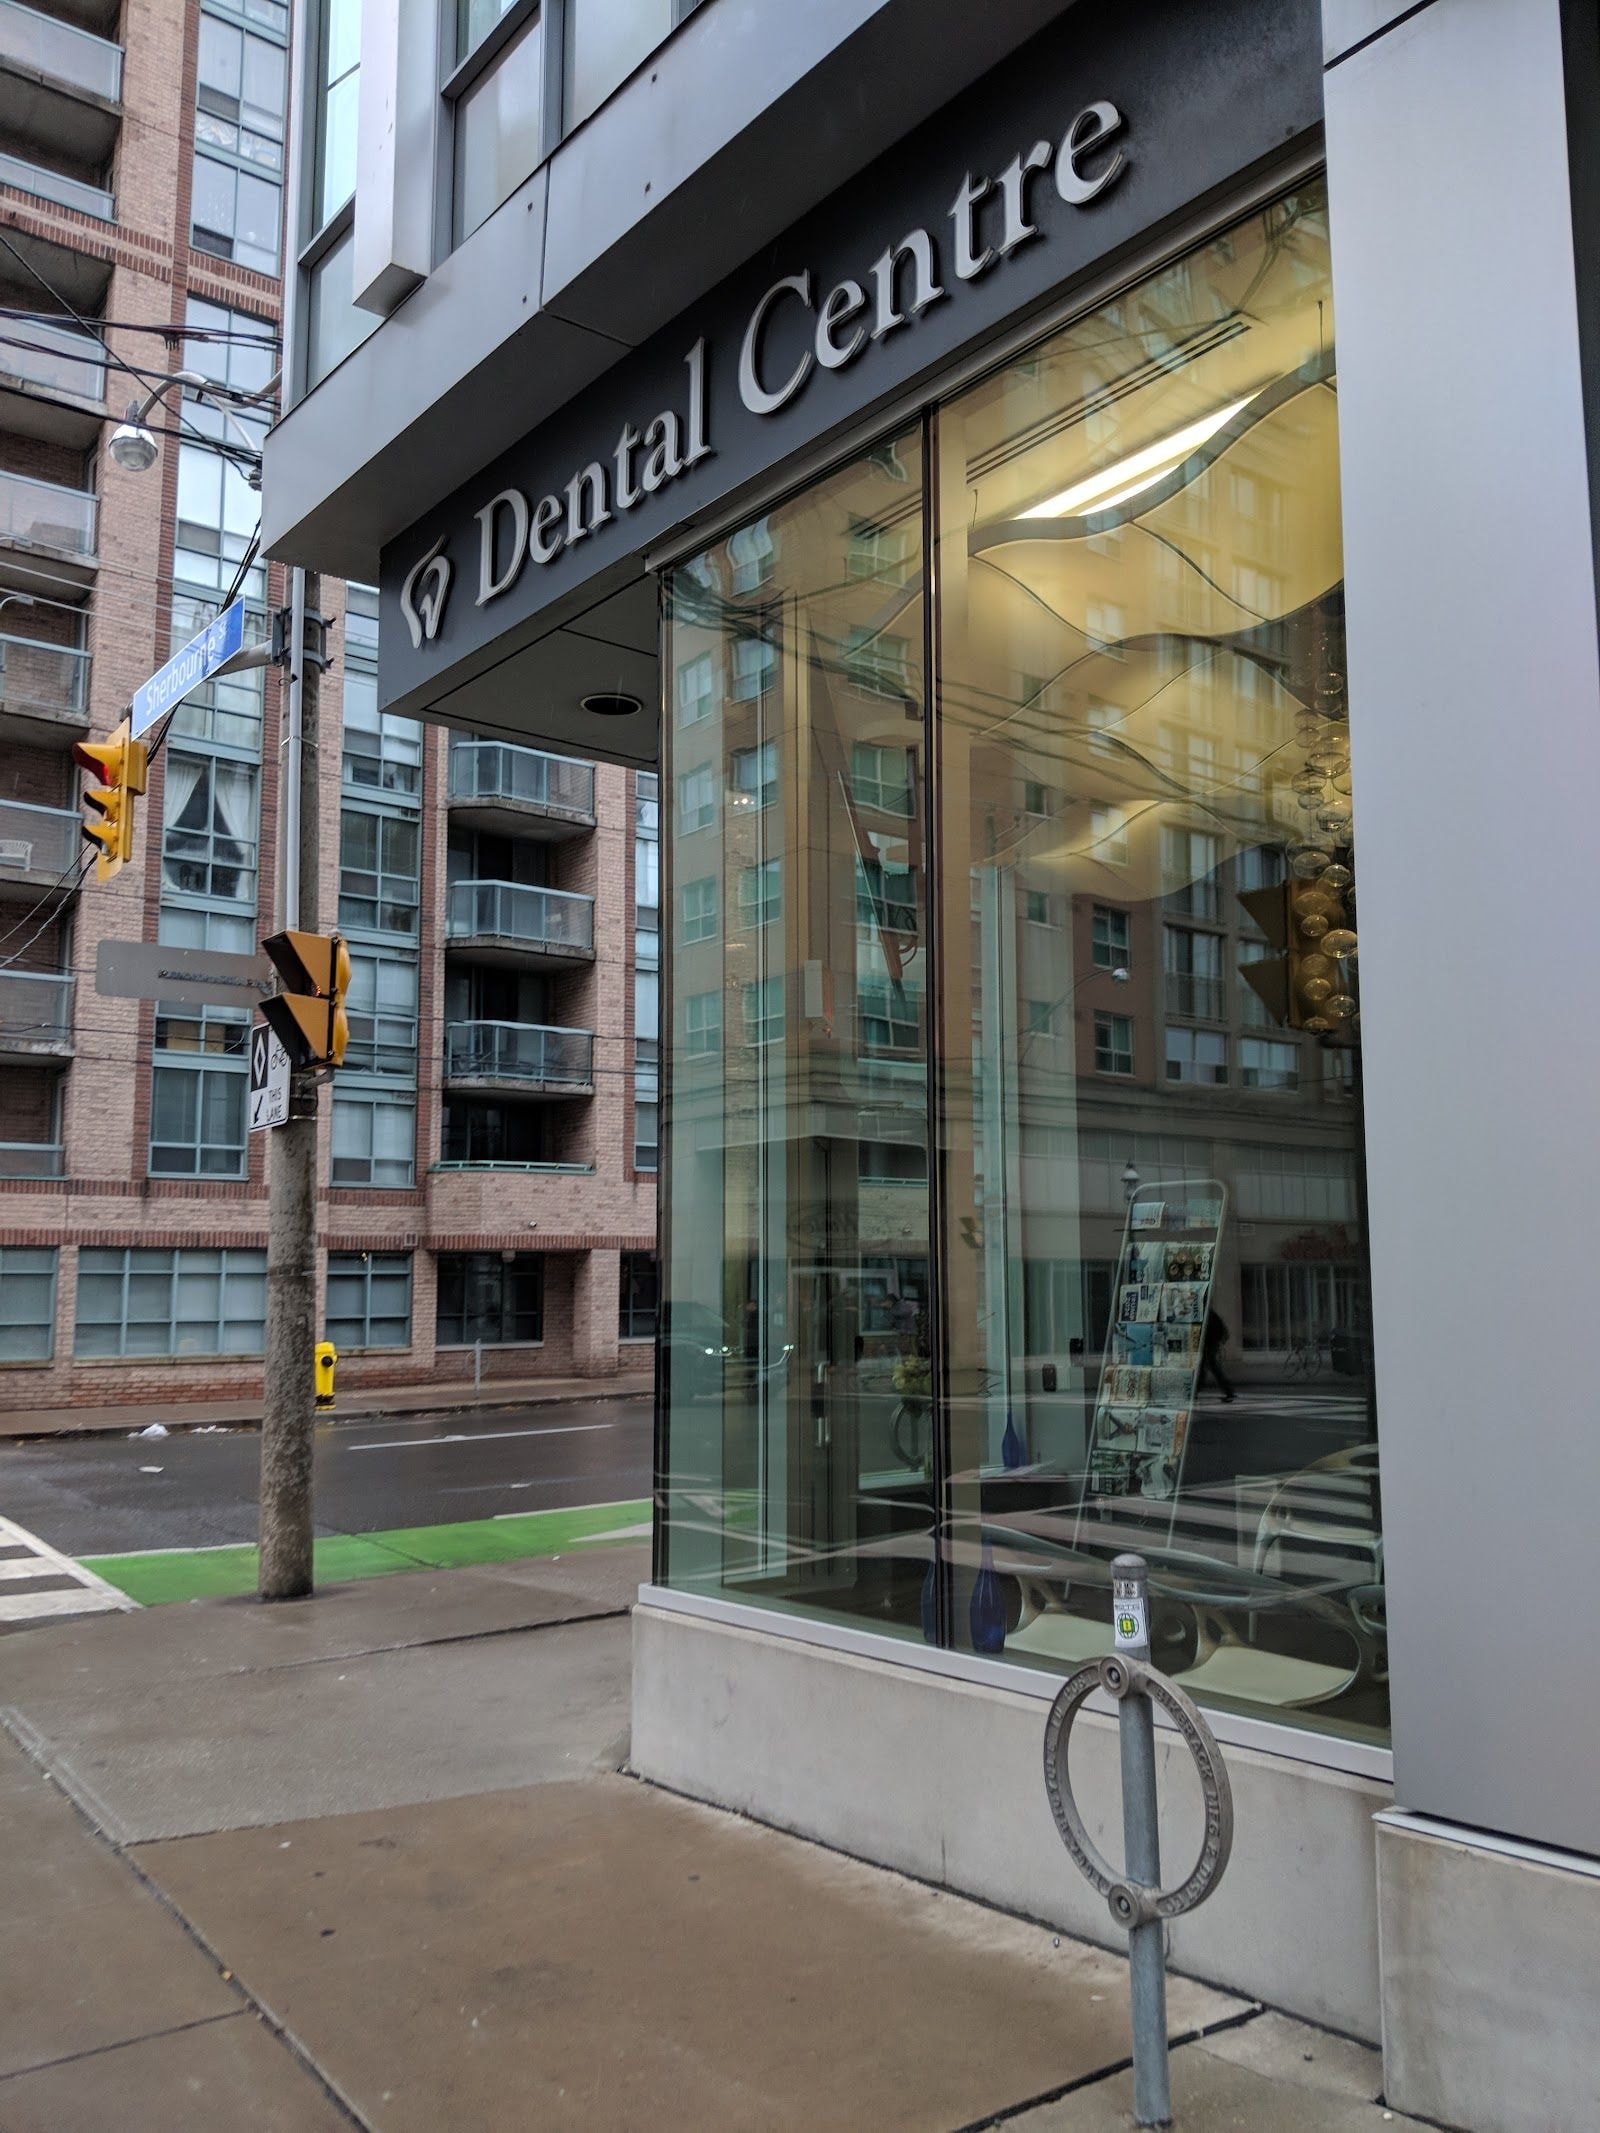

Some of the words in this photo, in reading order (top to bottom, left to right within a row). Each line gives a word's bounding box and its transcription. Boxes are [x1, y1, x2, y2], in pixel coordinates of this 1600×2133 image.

[473, 337, 712, 606] Dental
[738, 99, 1123, 416] Centre
[145, 635, 216, 716] Sherbourne
[268, 1086, 282, 1103] THIS
